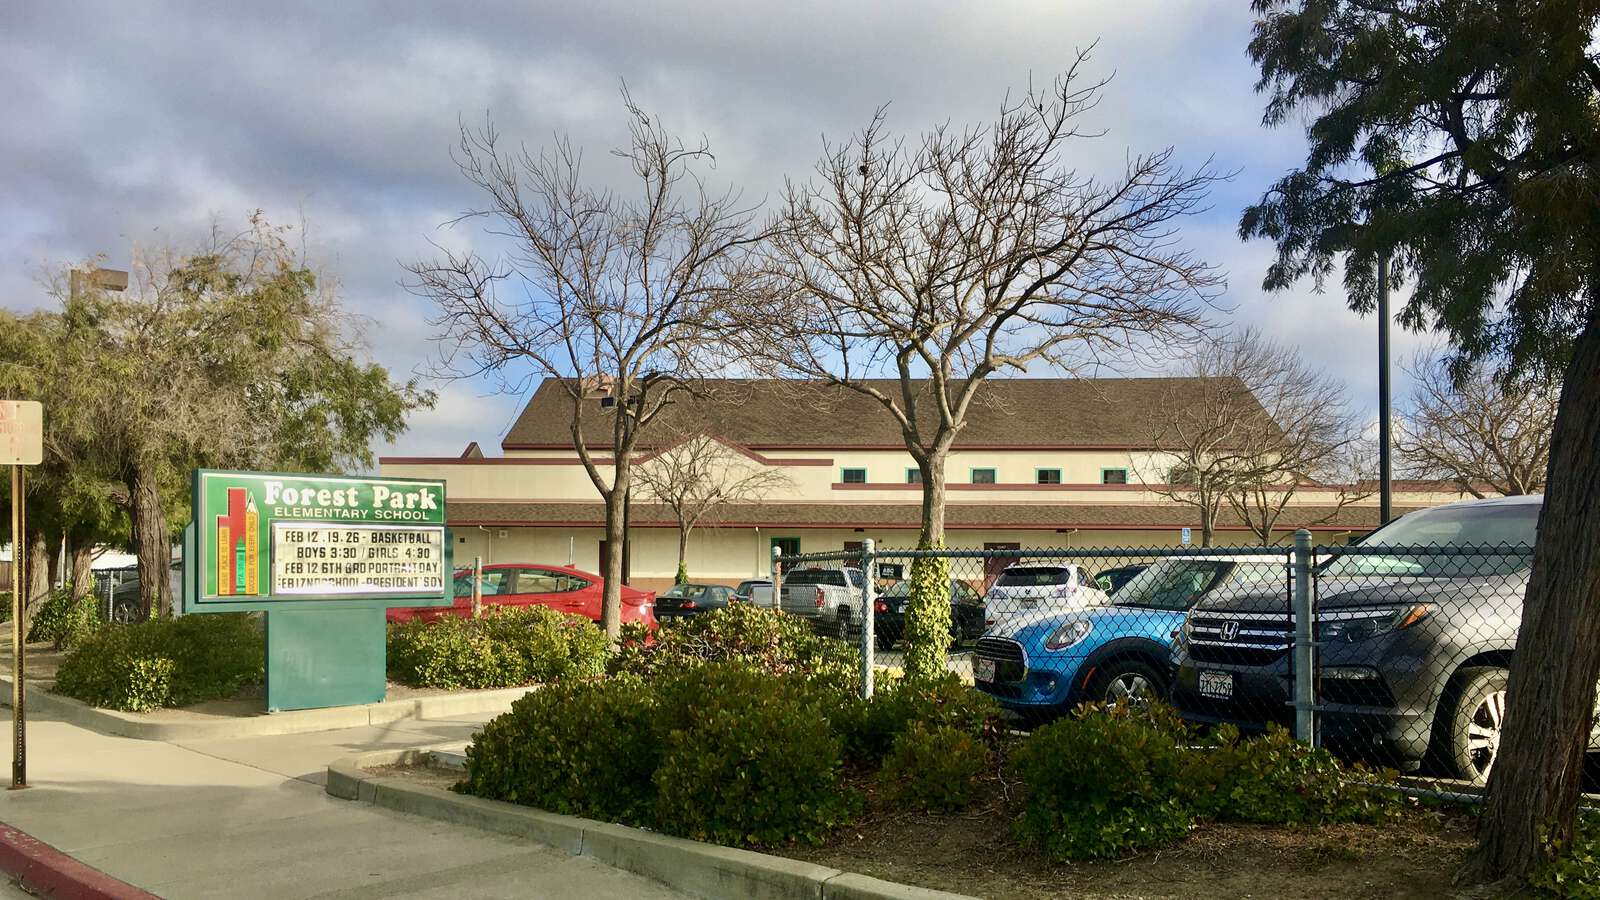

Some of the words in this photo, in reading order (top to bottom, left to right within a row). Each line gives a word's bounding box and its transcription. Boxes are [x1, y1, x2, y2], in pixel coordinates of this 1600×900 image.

[264, 481, 359, 507] Forest
[372, 486, 437, 510] Park
[274, 507, 368, 519] ELEMENTARY
[374, 509, 430, 521] SCHOOL
[285, 531, 304, 542] FEB
[371, 532, 431, 544] BASKETBALL
[297, 547, 326, 558] BOYS
[330, 547, 357, 558] 3:30
[368, 547, 398, 558] GIRLS
[405, 548, 430, 558] 4:30
[285, 562, 303, 574] FEB
[307, 562, 318, 573] 12
[321, 562, 342, 574] 6TH
[419, 562, 438, 573] DAY
